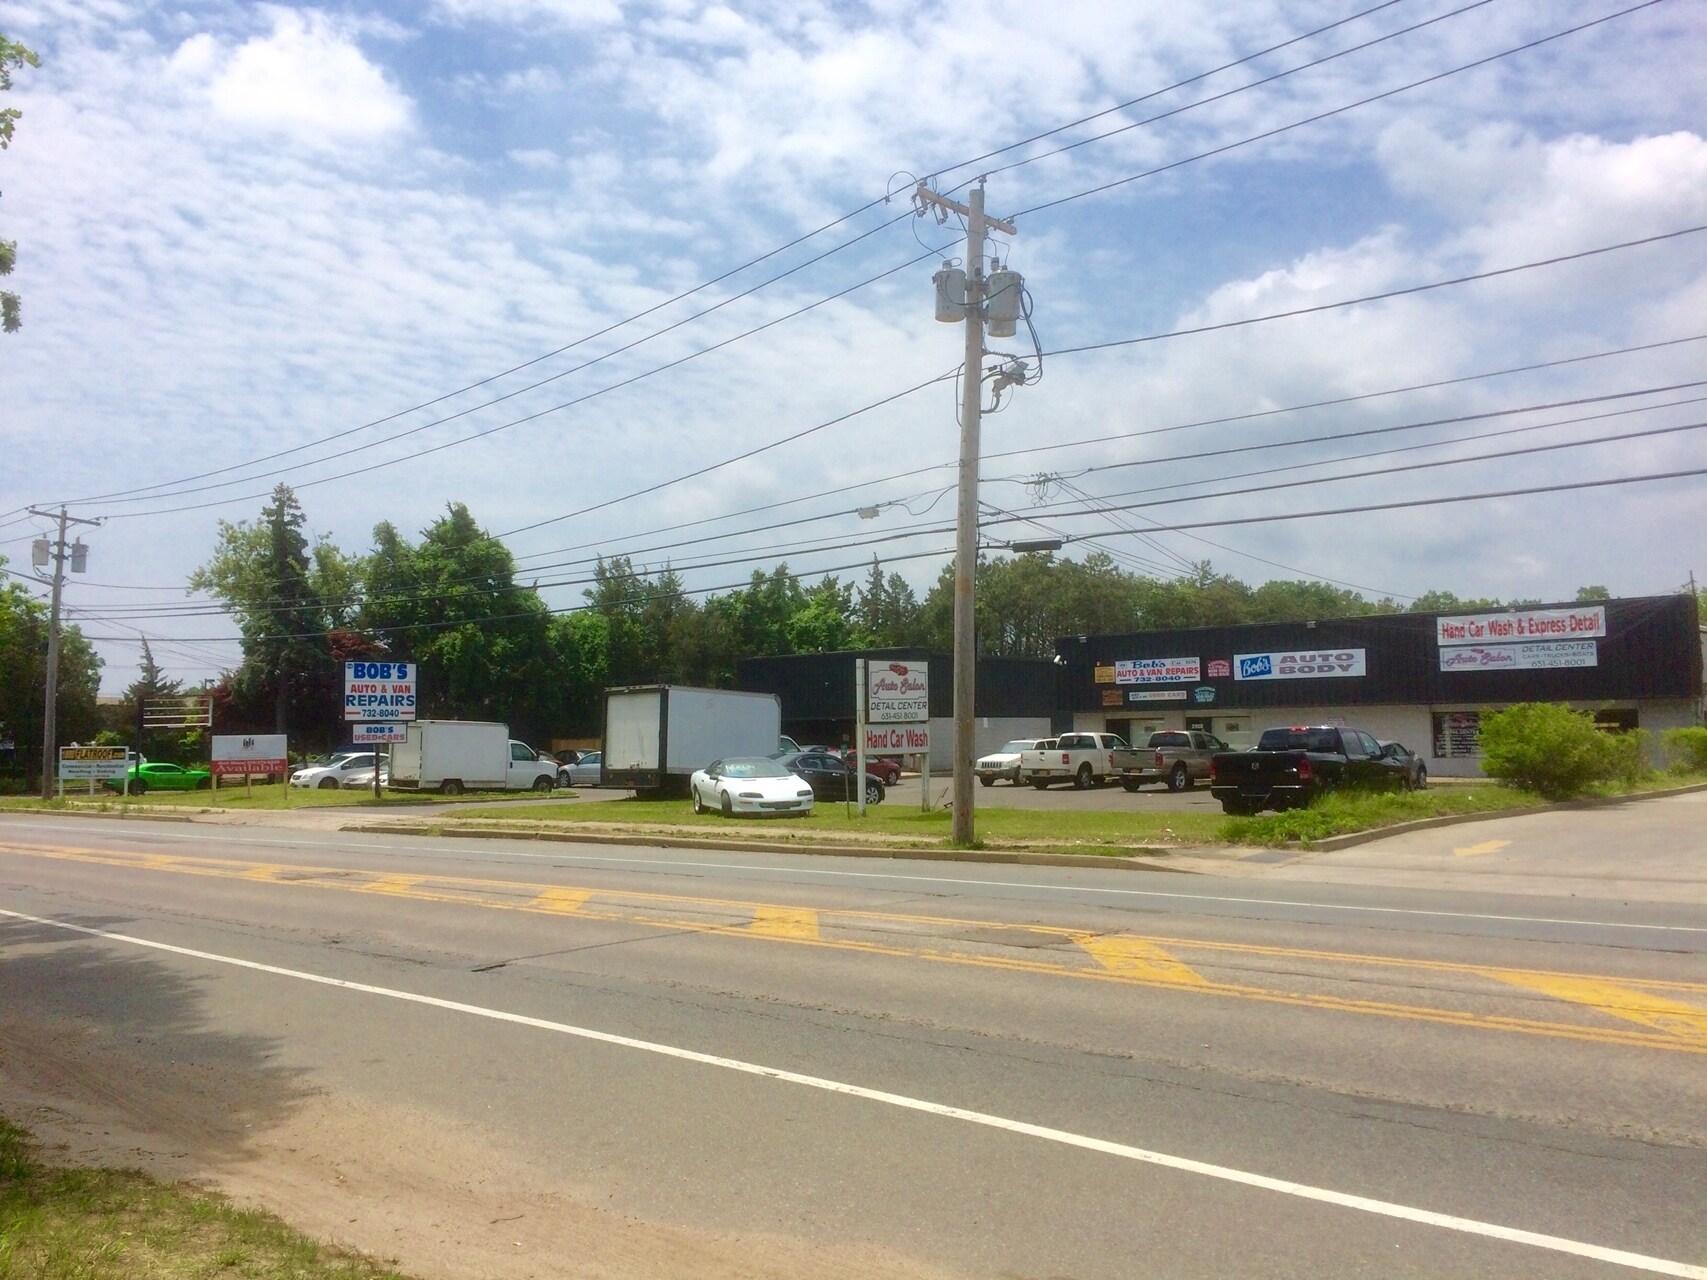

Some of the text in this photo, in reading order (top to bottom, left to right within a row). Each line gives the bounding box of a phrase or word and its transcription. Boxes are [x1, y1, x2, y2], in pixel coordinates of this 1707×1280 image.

[1442, 612, 1599, 639] Hand Car Wash & Express Detail
[1280, 653, 1354, 663] AUTO
[1446, 654, 1477, 666] Auto
[1531, 659, 1585, 667] 631-451-8001
[1131, 660, 1166, 669] Bob's
[1242, 657, 1269, 676] Bob's
[1280, 664, 1354, 674] BODY
[354, 663, 408, 679] BOB'S
[1117, 669, 1137, 677] AUTO
[1166, 667, 1199, 675] REPAIRS
[350, 684, 411, 693] AUTO & VAN
[872, 678, 898, 696] Auto
[346, 695, 415, 706] REPAIRS
[870, 701, 927, 710] DETAIL CENTER
[866, 728, 928, 748] Hand Car Wash
[216, 764, 283, 772] Available
